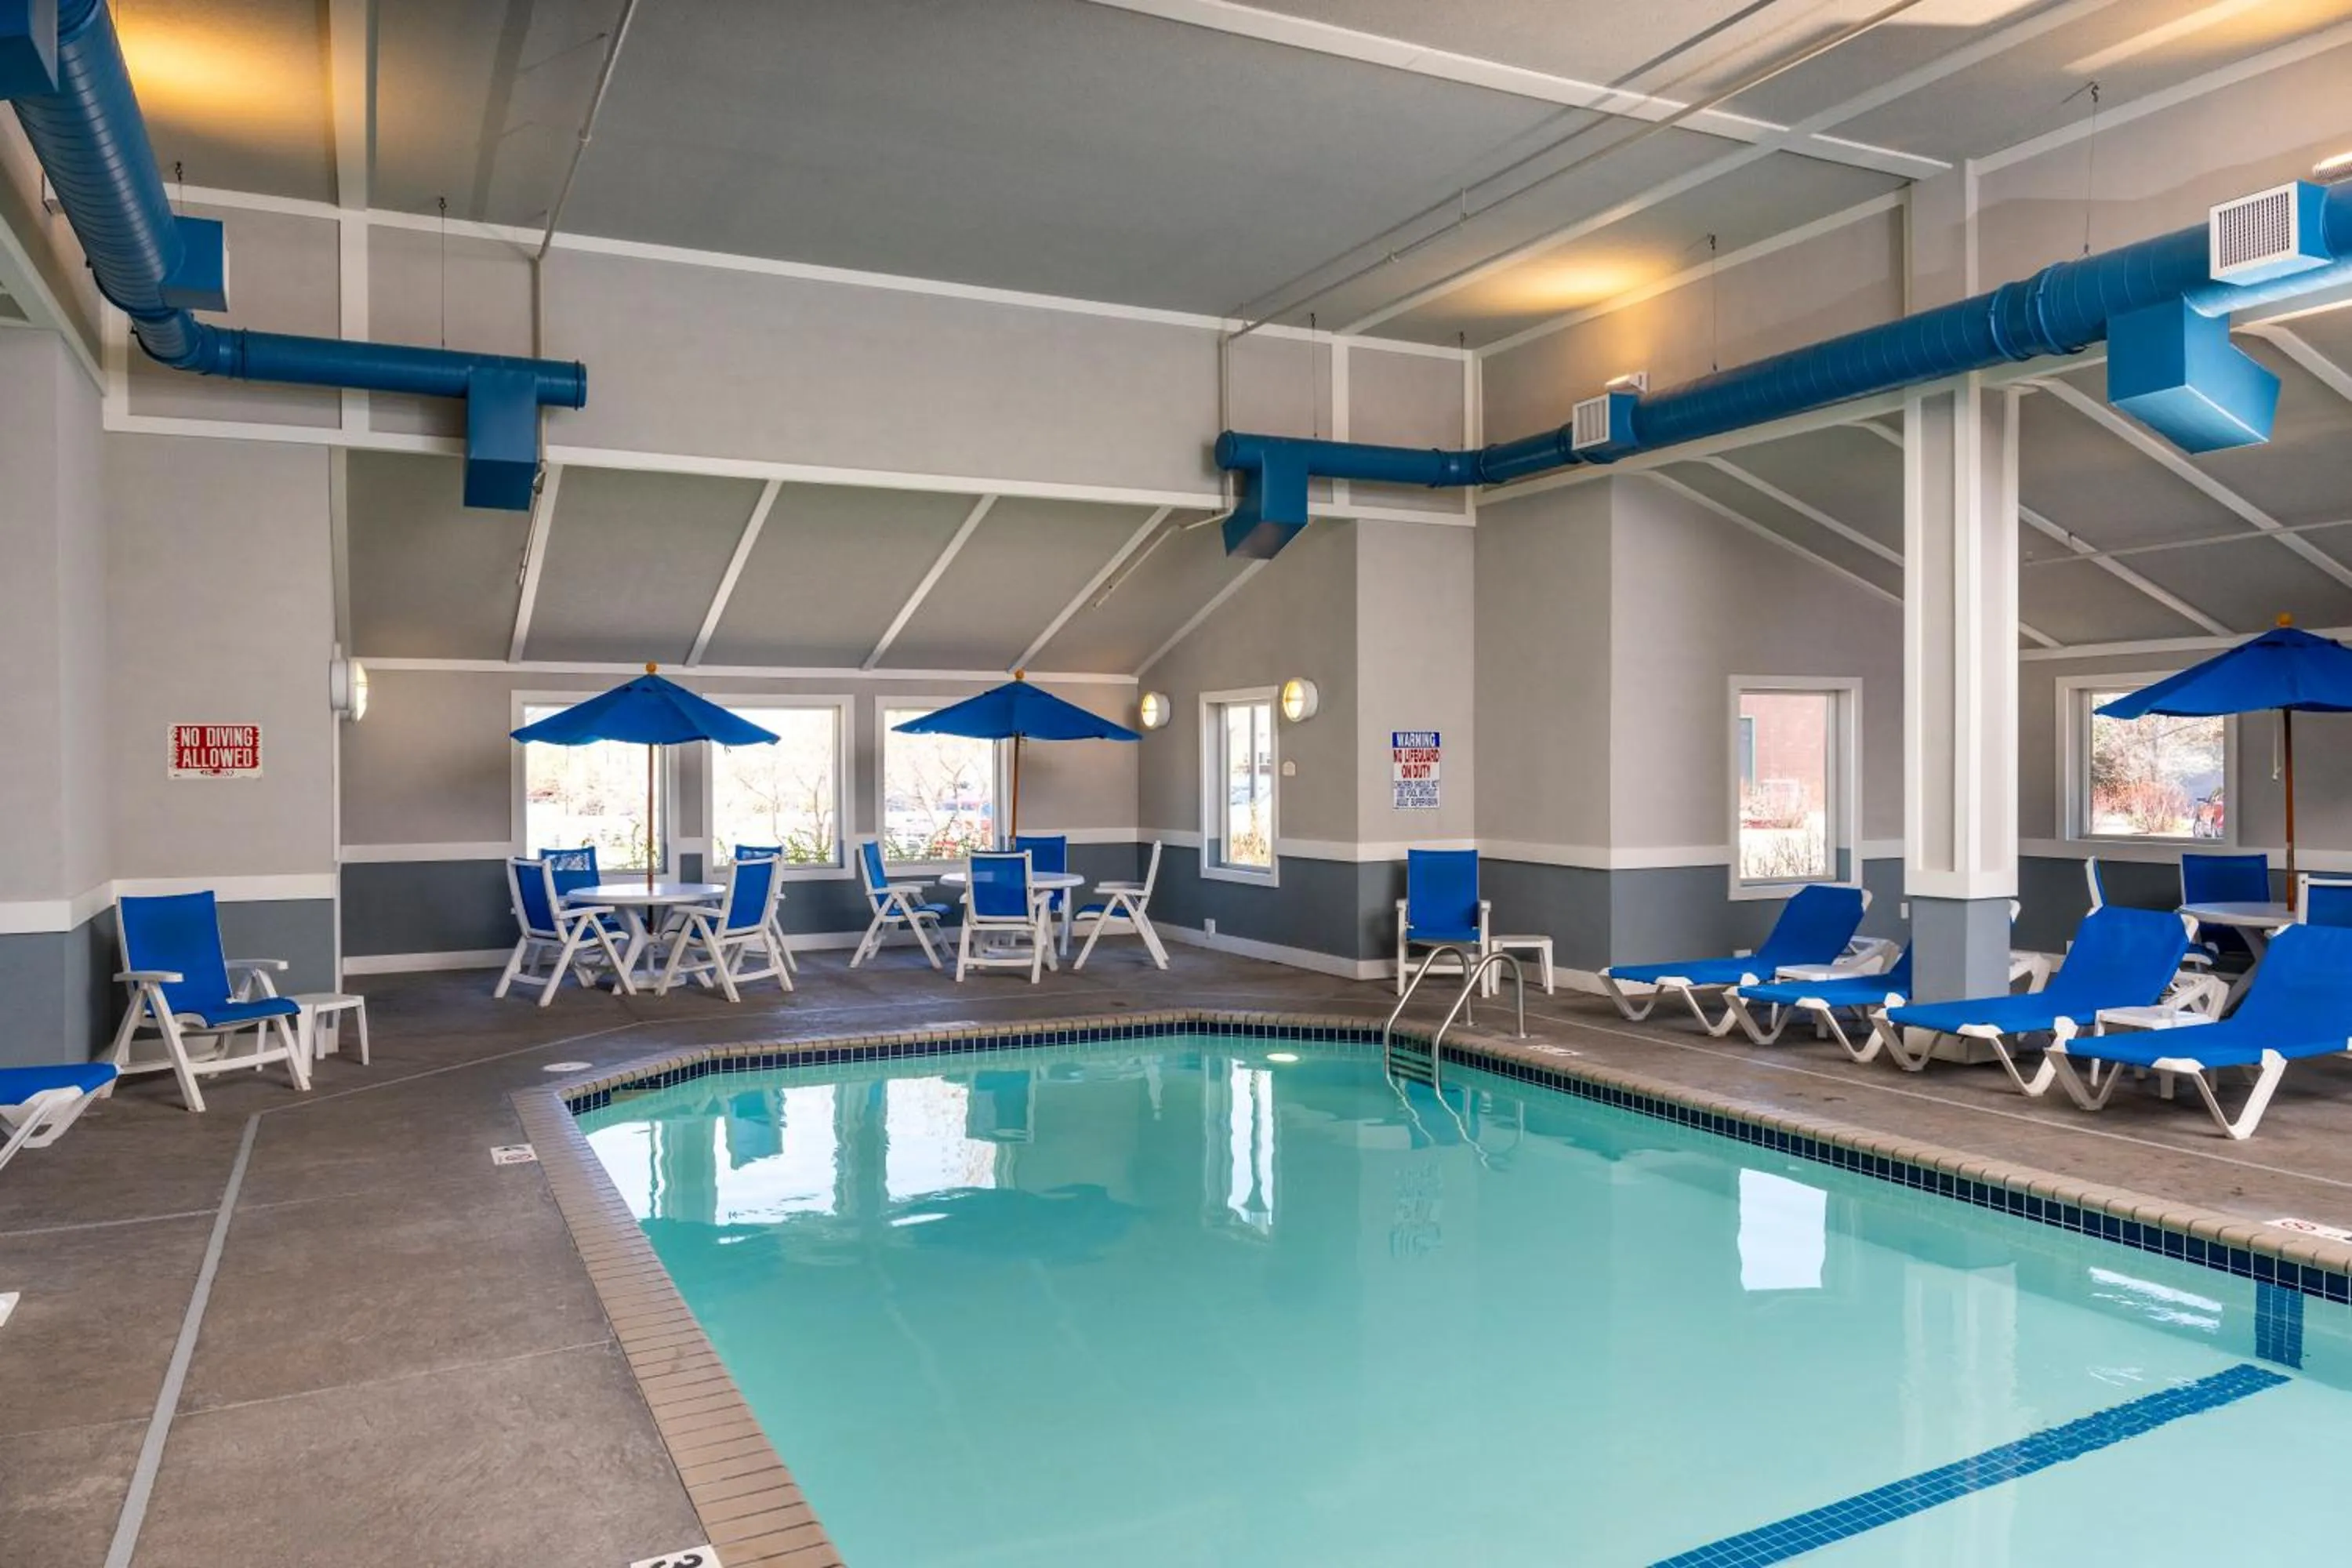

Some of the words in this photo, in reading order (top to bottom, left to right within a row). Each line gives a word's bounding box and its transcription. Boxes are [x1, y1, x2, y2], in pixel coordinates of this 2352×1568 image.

[181, 727, 200, 747] NO
[206, 727, 253, 747] DIVING
[1396, 732, 1436, 747] WARNING
[182, 747, 252, 768] ALLOWED
[1401, 764, 1412, 779] ON
[1414, 764, 1431, 779] DUTY
